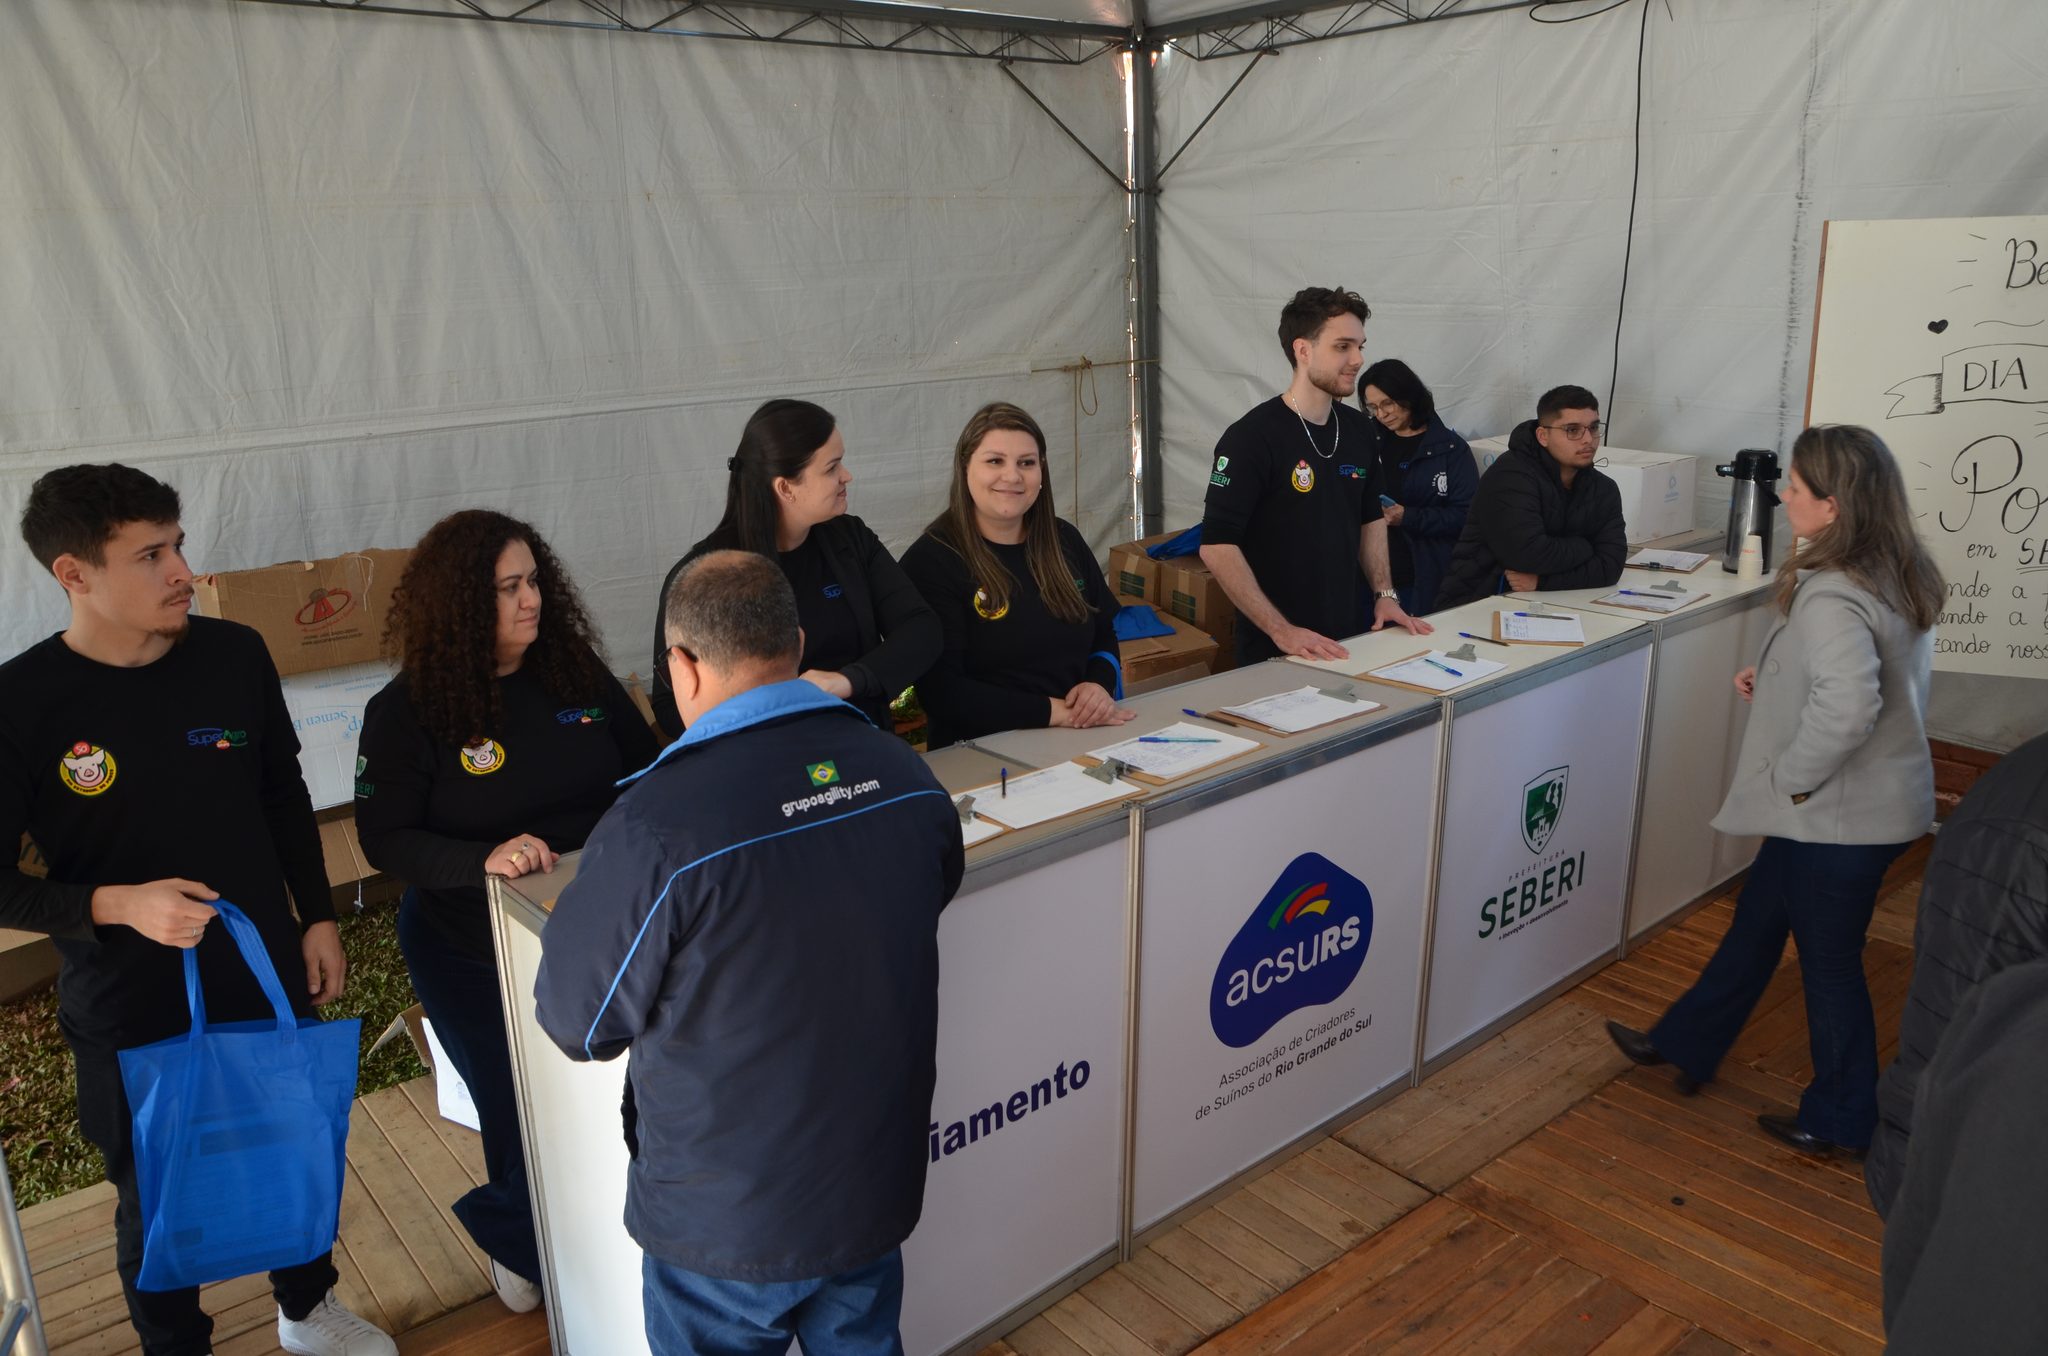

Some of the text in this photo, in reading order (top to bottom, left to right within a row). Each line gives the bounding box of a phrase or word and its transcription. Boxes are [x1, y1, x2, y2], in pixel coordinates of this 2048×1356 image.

[1963, 357, 2028, 392] DIA
[1967, 543, 1997, 559] em
[2011, 585, 2028, 599] a
[2009, 611, 2028, 626] a
[781, 780, 880, 817] grupoagility.com
[1478, 850, 1585, 939] SEBERI
[1219, 1006, 1356, 1088] Associação de Criadores
[1195, 1014, 1372, 1120] de Suínos do Rio Grande do Sul
